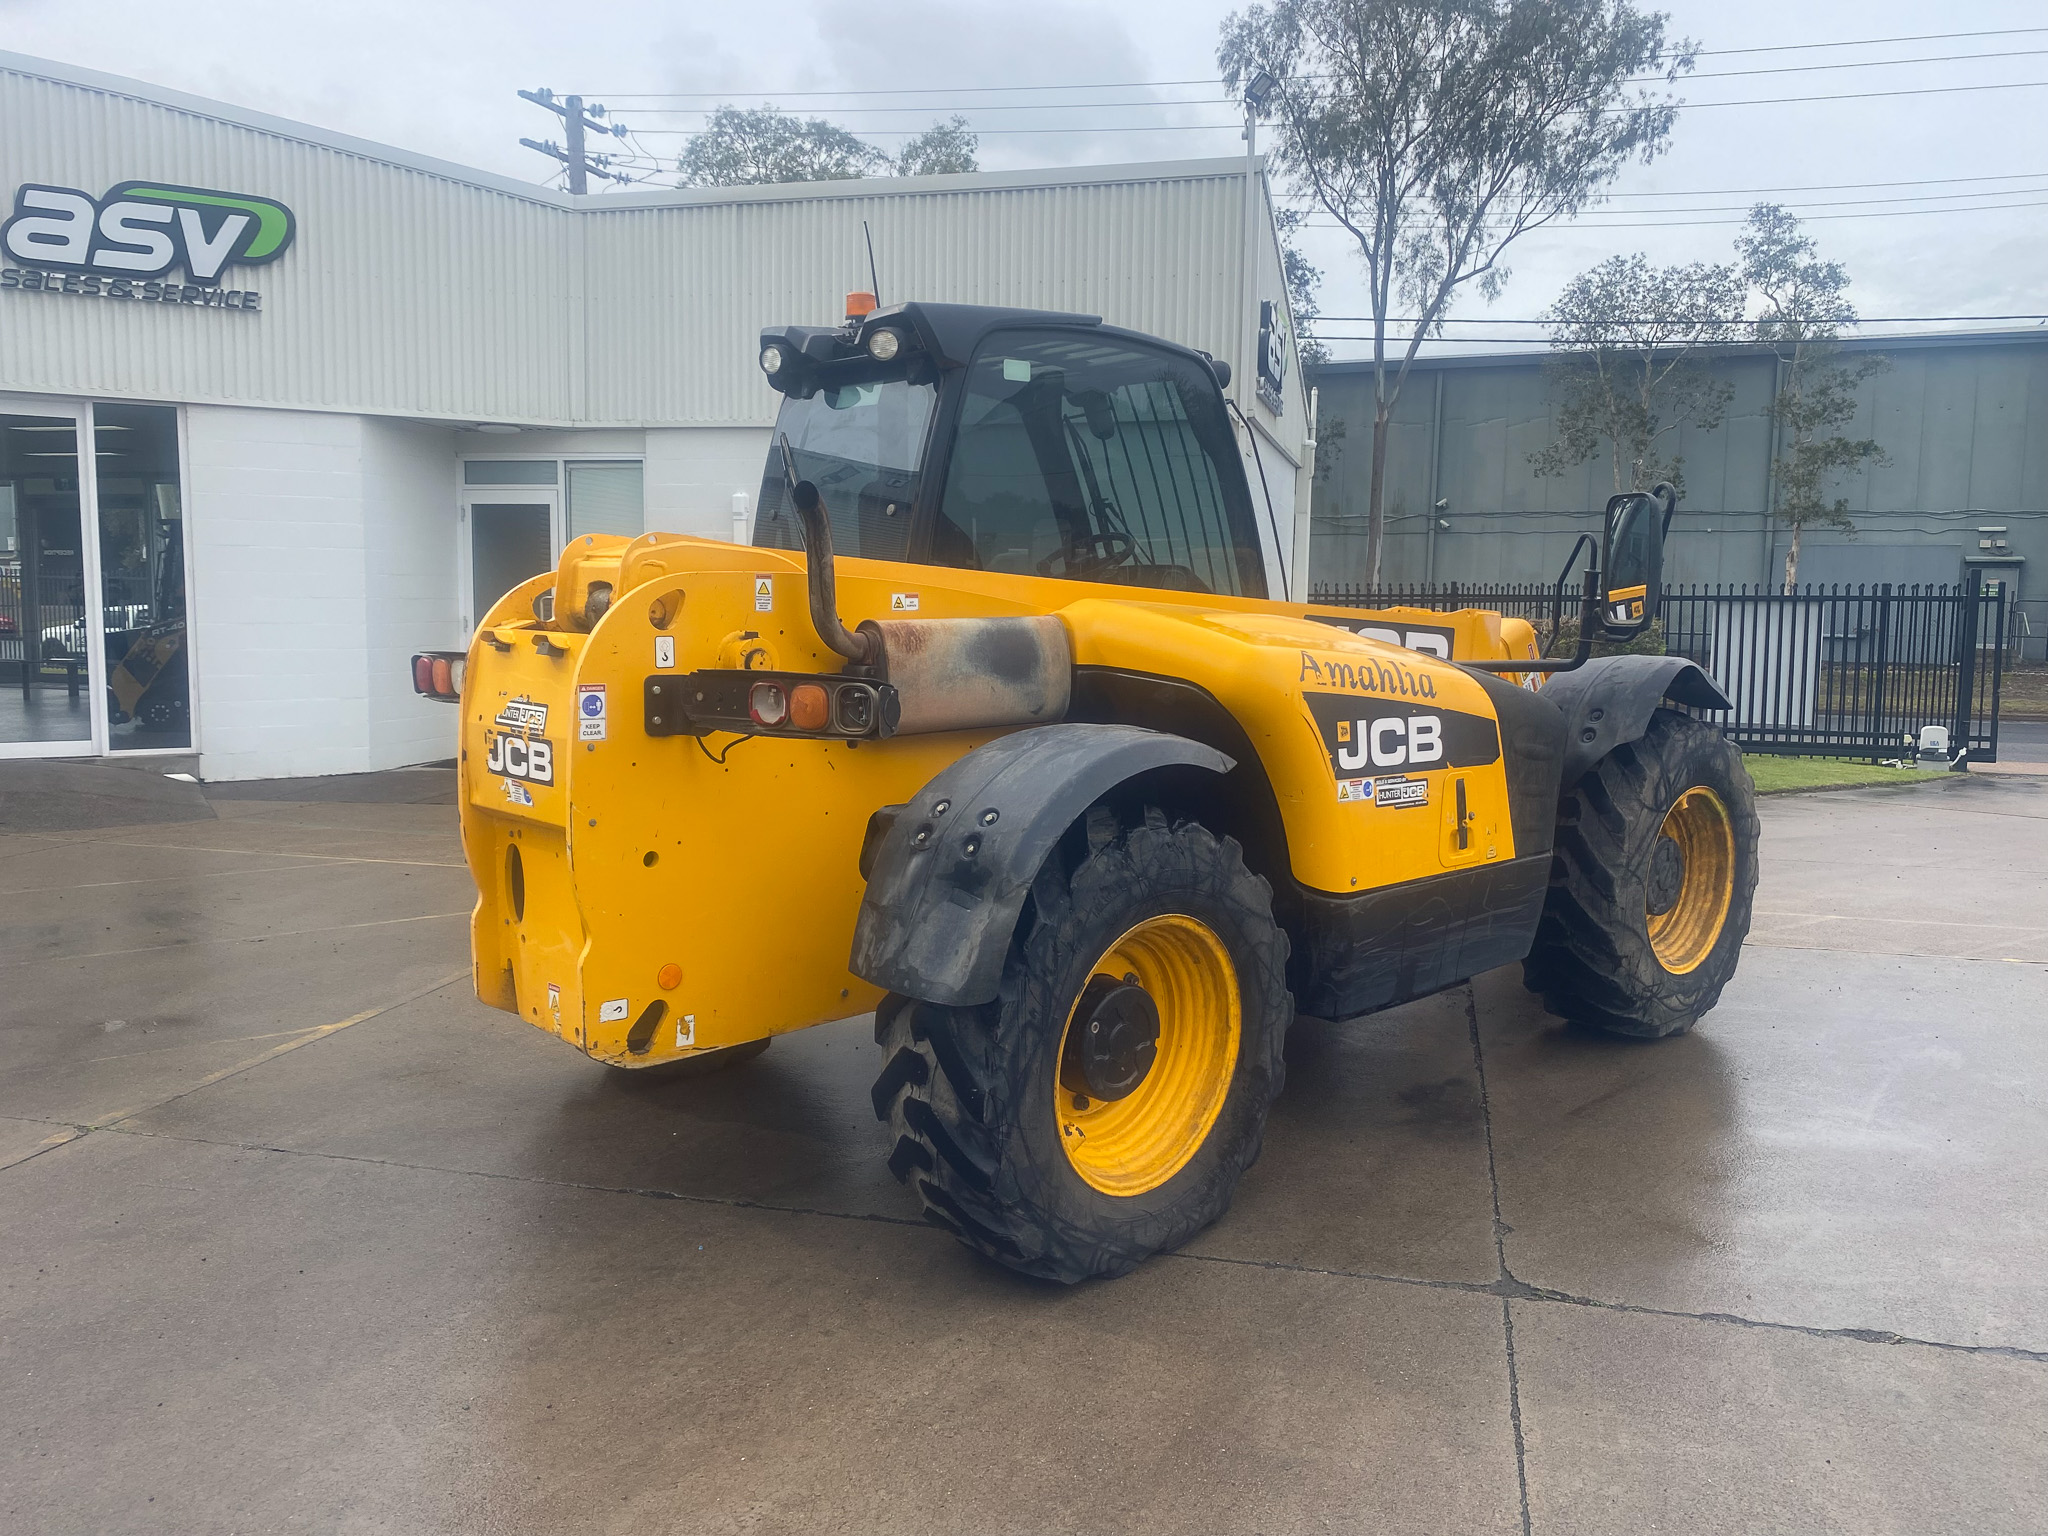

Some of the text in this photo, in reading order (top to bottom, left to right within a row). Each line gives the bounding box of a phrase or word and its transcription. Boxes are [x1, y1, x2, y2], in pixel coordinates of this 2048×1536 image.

[107, 279, 134, 299] &
[142, 282, 260, 310] SERVICE
[151, 621, 186, 637] RT-40
[1337, 714, 1443, 770] JCB
[487, 734, 552, 782] JCB
[1379, 788, 1401, 800] HUNTER
[1403, 786, 1424, 797] JCB
